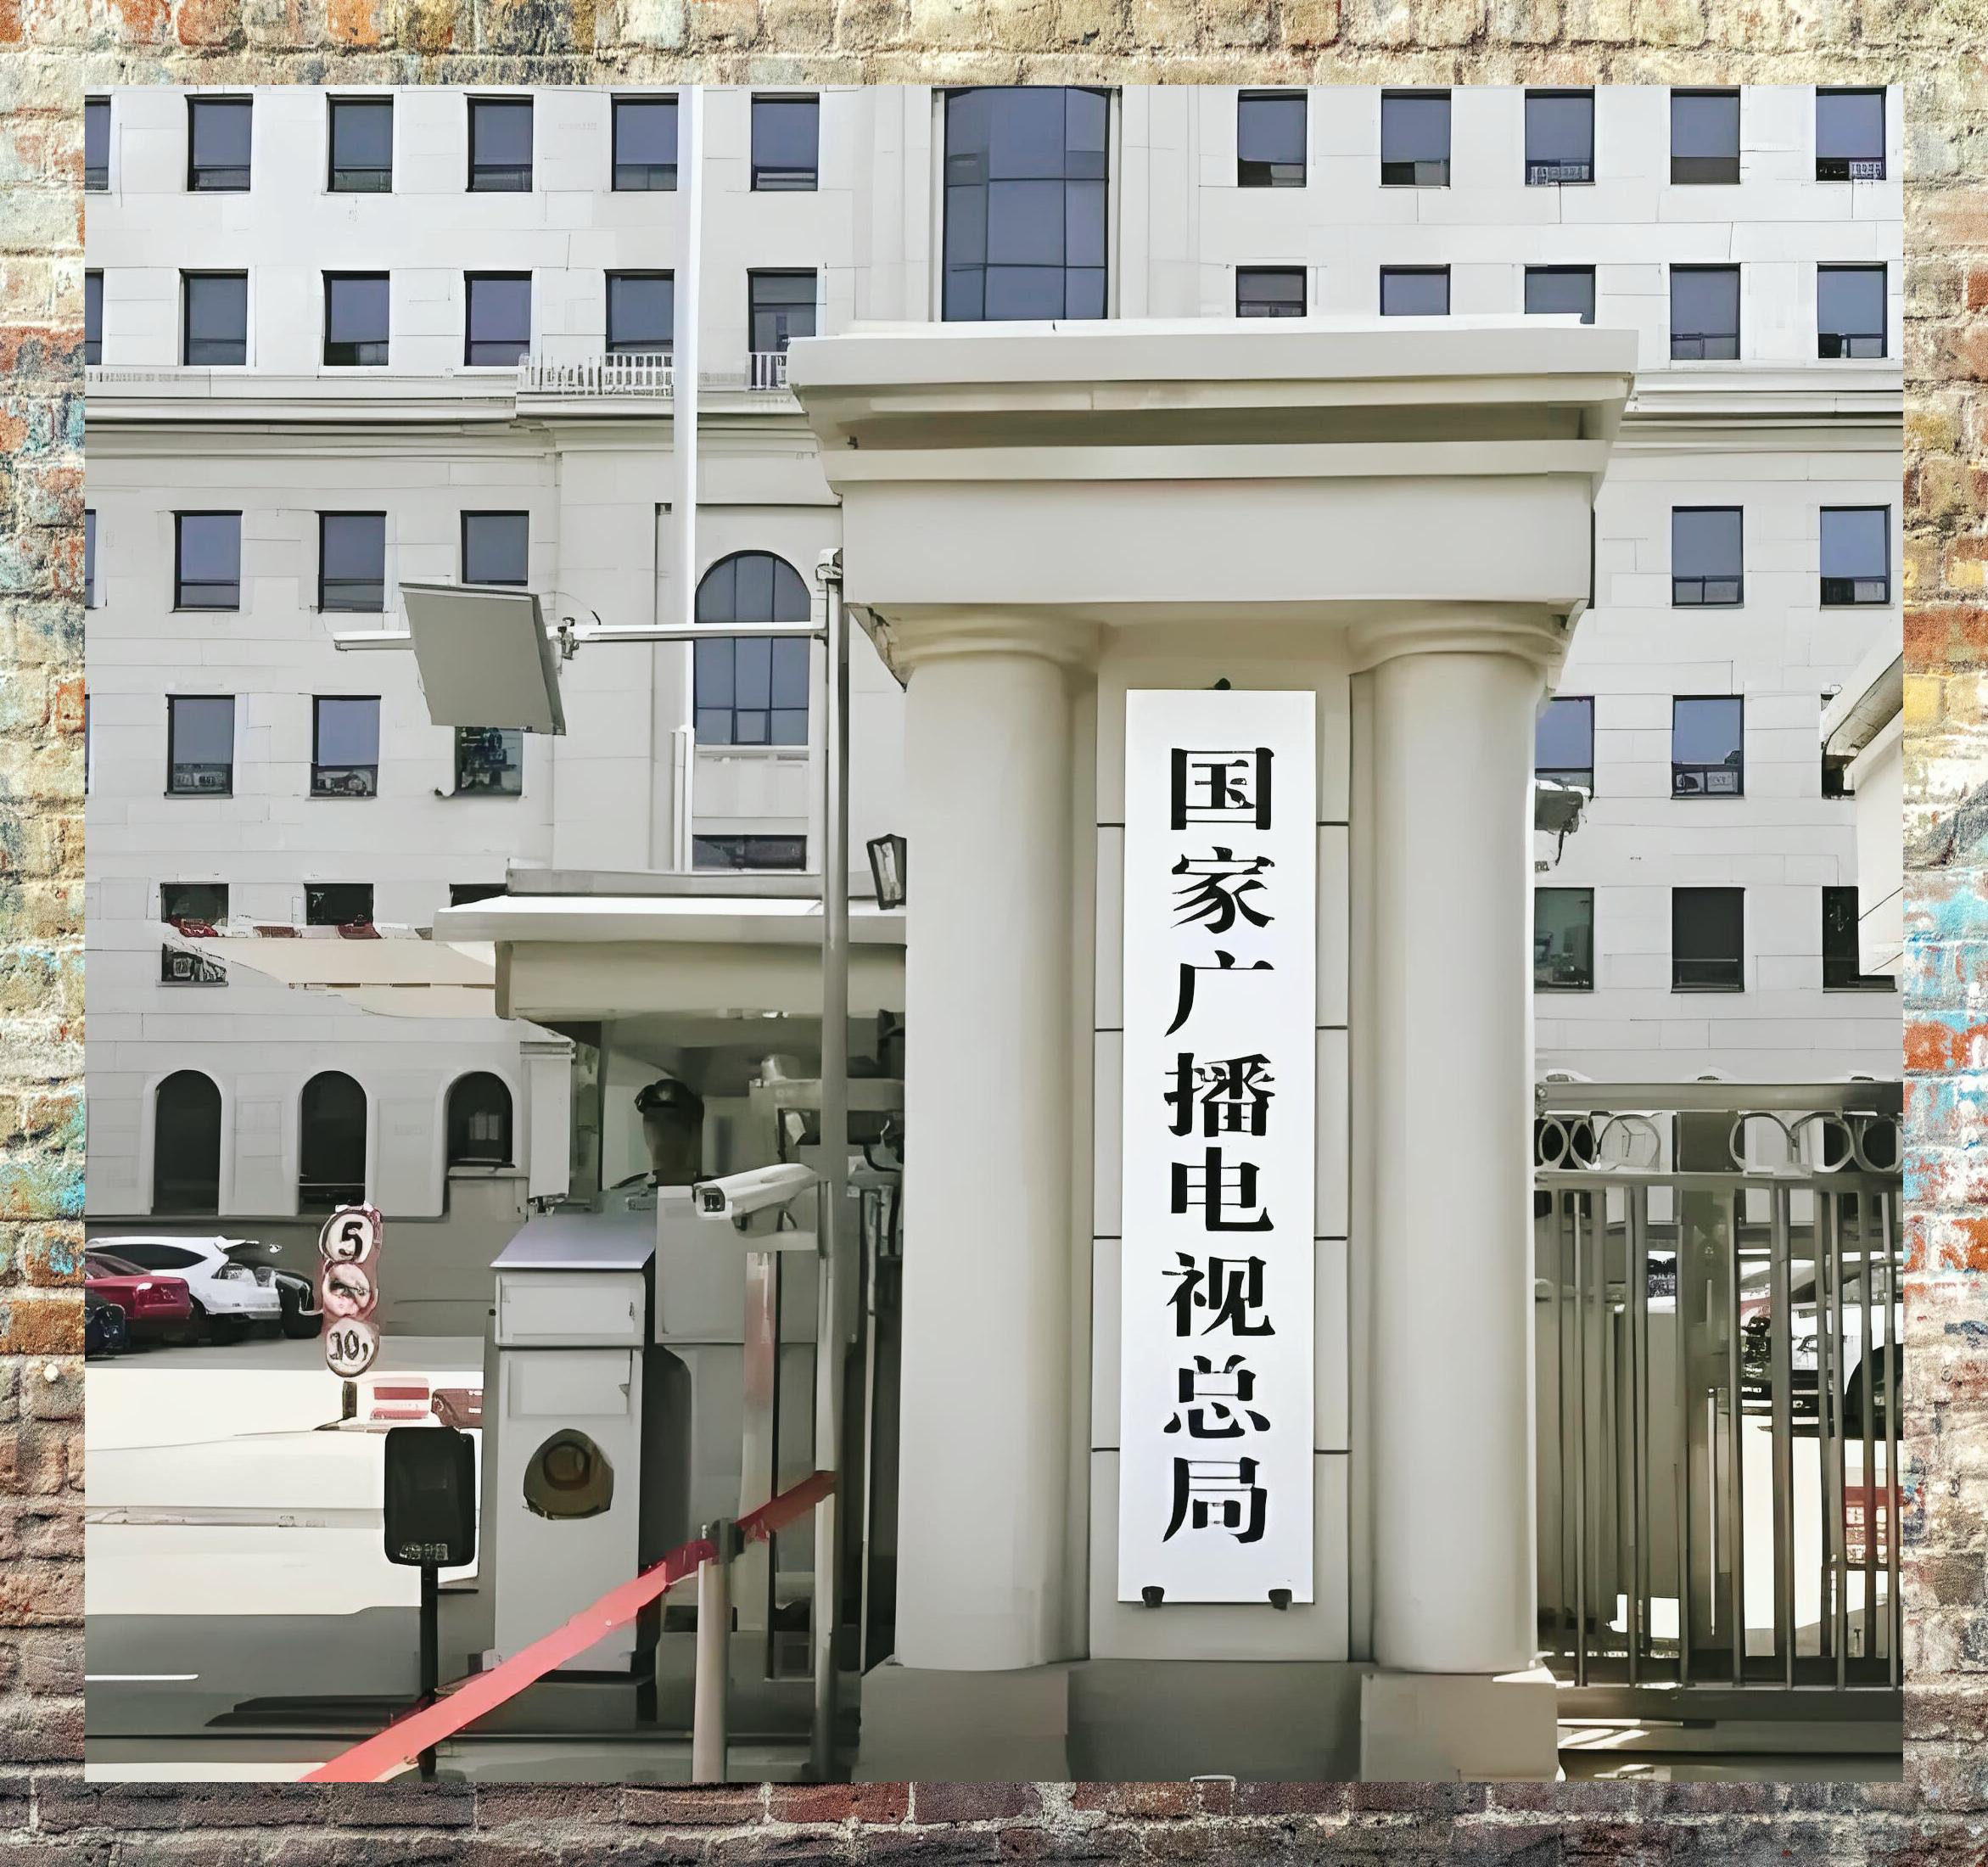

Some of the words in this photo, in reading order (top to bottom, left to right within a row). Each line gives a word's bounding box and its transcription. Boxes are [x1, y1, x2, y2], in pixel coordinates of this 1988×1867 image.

[339, 1221, 363, 1262] 5
[1162, 747, 1276, 1544] 国家广播电视总局
